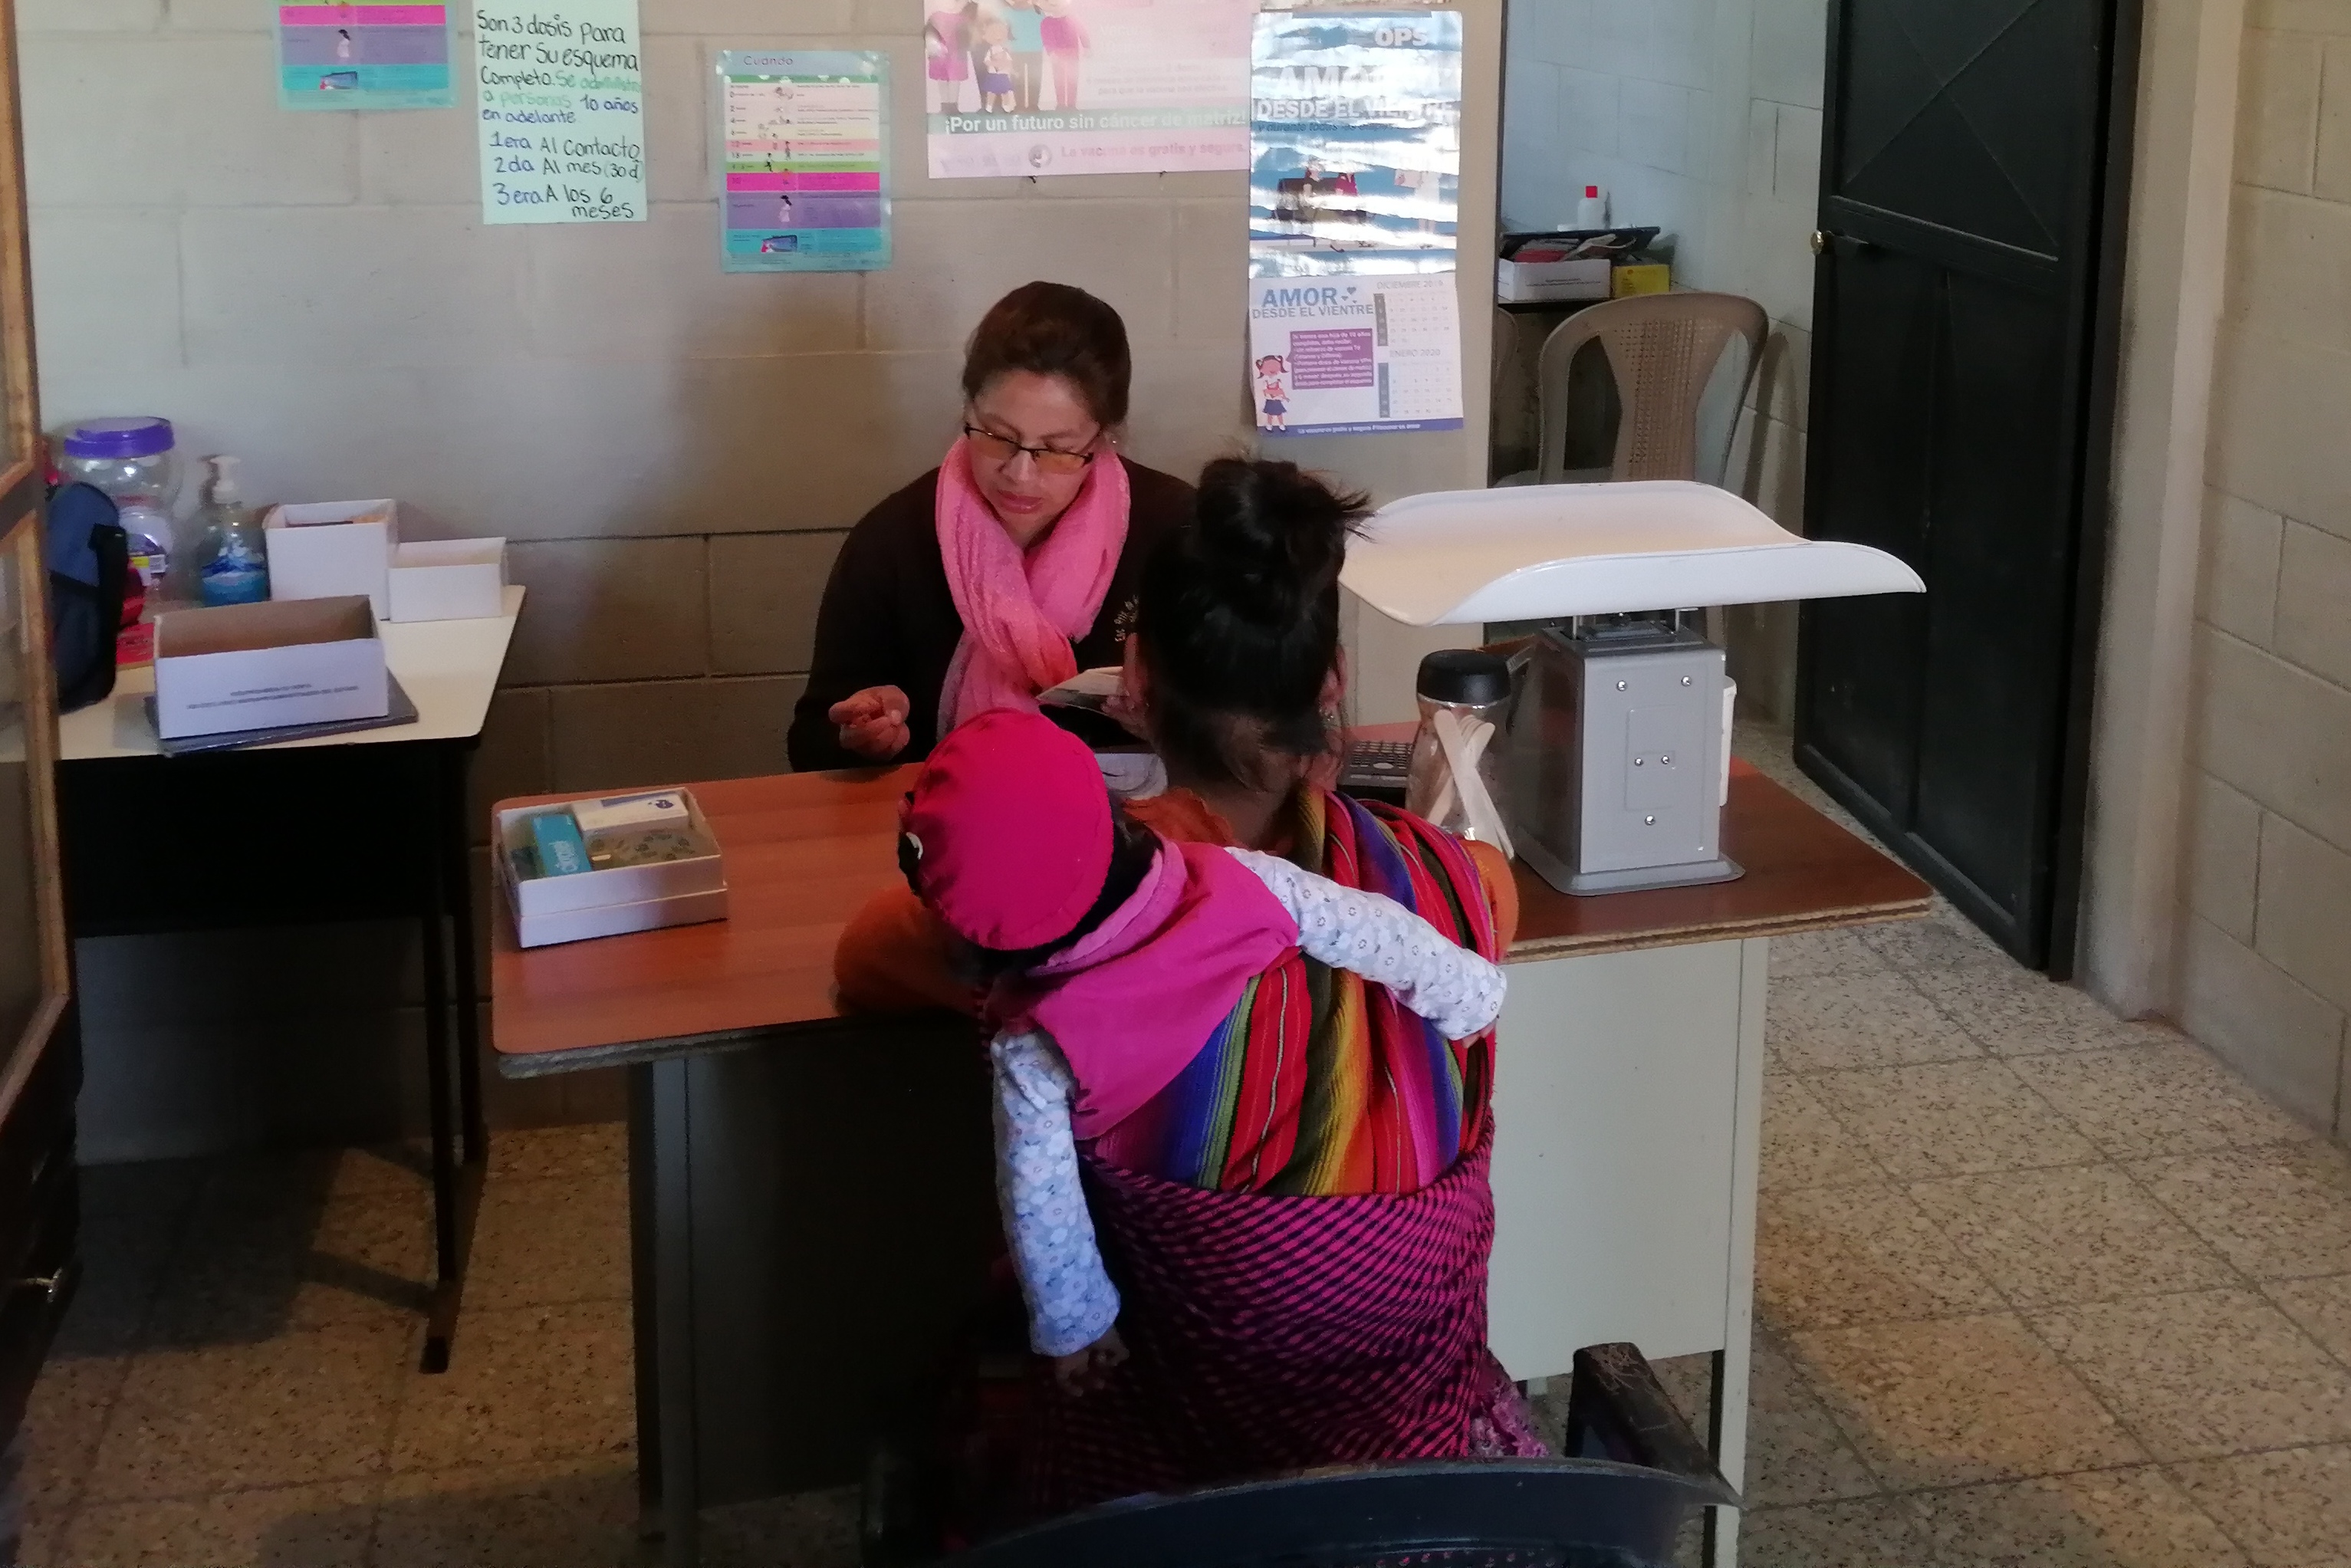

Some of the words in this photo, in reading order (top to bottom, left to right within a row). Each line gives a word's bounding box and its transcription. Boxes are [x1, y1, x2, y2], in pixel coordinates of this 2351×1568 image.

[476, 9, 509, 31] Son
[511, 16, 524, 35] 3
[526, 14, 573, 38] dosis
[478, 35, 531, 61] tener
[562, 48, 640, 77] esquema
[580, 94, 599, 111] 10
[603, 97, 640, 114] años
[505, 110, 577, 123] adelante
[985, 118, 1008, 131] un
[1011, 115, 1064, 130] futuro
[1069, 114, 1094, 130] sin
[1100, 112, 1155, 128] cáncer
[1162, 113, 1181, 127] de
[566, 159, 602, 176] mes
[563, 183, 590, 204] los
[600, 187, 613, 204] 6
[571, 202, 634, 220] meses
[1261, 288, 1338, 307] AMOR
[1252, 305, 1295, 319] DESDE
[1300, 305, 1315, 317] EL
[1320, 304, 1374, 317] VIENTRE
